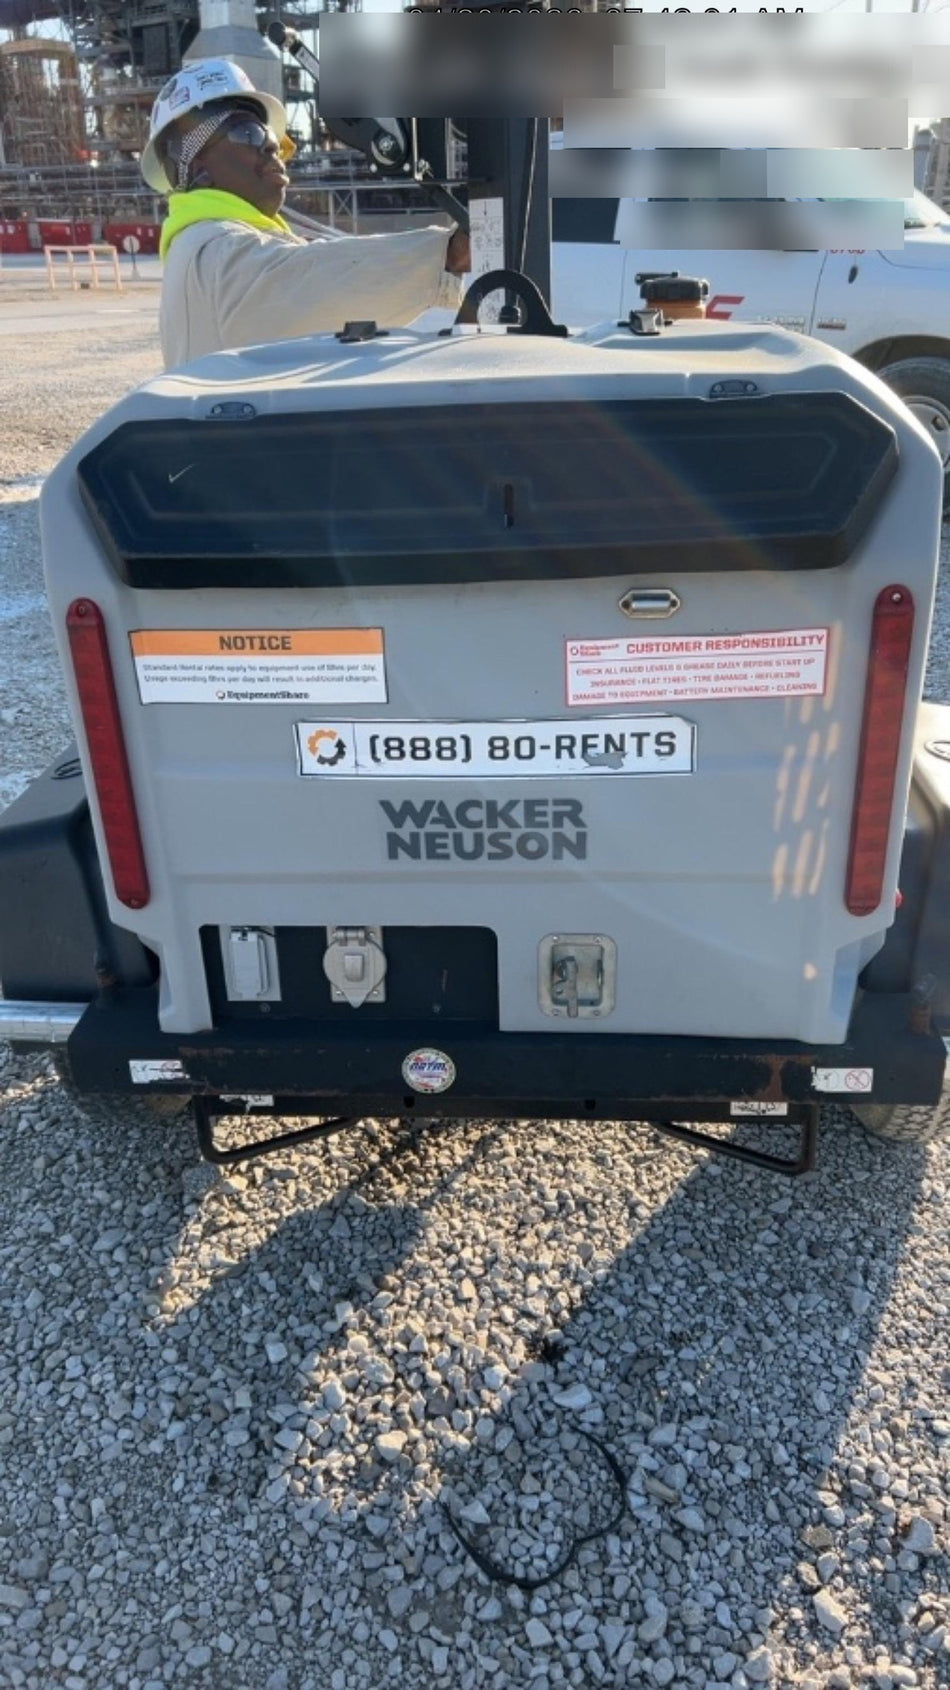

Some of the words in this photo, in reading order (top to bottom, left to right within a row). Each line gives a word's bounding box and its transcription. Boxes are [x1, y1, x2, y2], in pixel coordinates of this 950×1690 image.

[219, 636, 292, 651] NOTICE
[580, 643, 619, 651] Equipment
[626, 640, 702, 655] CUSTOMER
[705, 634, 825, 651] RESPONSIBILITY
[143, 664, 177, 672] Standard
[180, 664, 203, 672] Rental
[204, 664, 225, 672] rates
[227, 664, 247, 673] apply
[259, 664, 299, 673] equipment
[317, 664, 326, 672] of
[347, 664, 360, 673] per
[576, 667, 603, 676] CHECK
[605, 666, 619, 675] ALL
[620, 665, 644, 674] FLUID
[645, 663, 674, 673] LEVELS
[683, 661, 715, 671] GREASE
[717, 660, 741, 669] DAILY
[743, 659, 774, 668] BEFORE
[775, 658, 802, 667] START
[803, 657, 816, 665] UP
[144, 675, 168, 683] Usage
[170, 675, 207, 684] exceeding
[227, 676, 240, 684] per
[242, 675, 256, 684] day
[257, 675, 271, 683] will
[272, 675, 294, 683] result
[305, 675, 345, 683] additional
[590, 677, 636, 687] INSURANCE
[642, 676, 660, 685] FLAT
[662, 675, 687, 684] TIRES
[693, 674, 712, 683] TIRE
[714, 673, 748, 682] DAMAGE
[755, 671, 801, 681] REFUELING
[227, 690, 310, 701] EquipmentShare
[572, 692, 606, 701] DAMAGE
[608, 691, 619, 699] TO
[620, 688, 668, 699] EQUIPMENT
[674, 687, 709, 697] BATTERY
[711, 684, 769, 695] MAINTENANCE
[777, 682, 818, 692] CLEANING
[369, 734, 472, 763] (888)
[488, 731, 677, 761] 80-RENTS
[379, 798, 588, 829] WACKER
[385, 830, 588, 861] NEUSON
